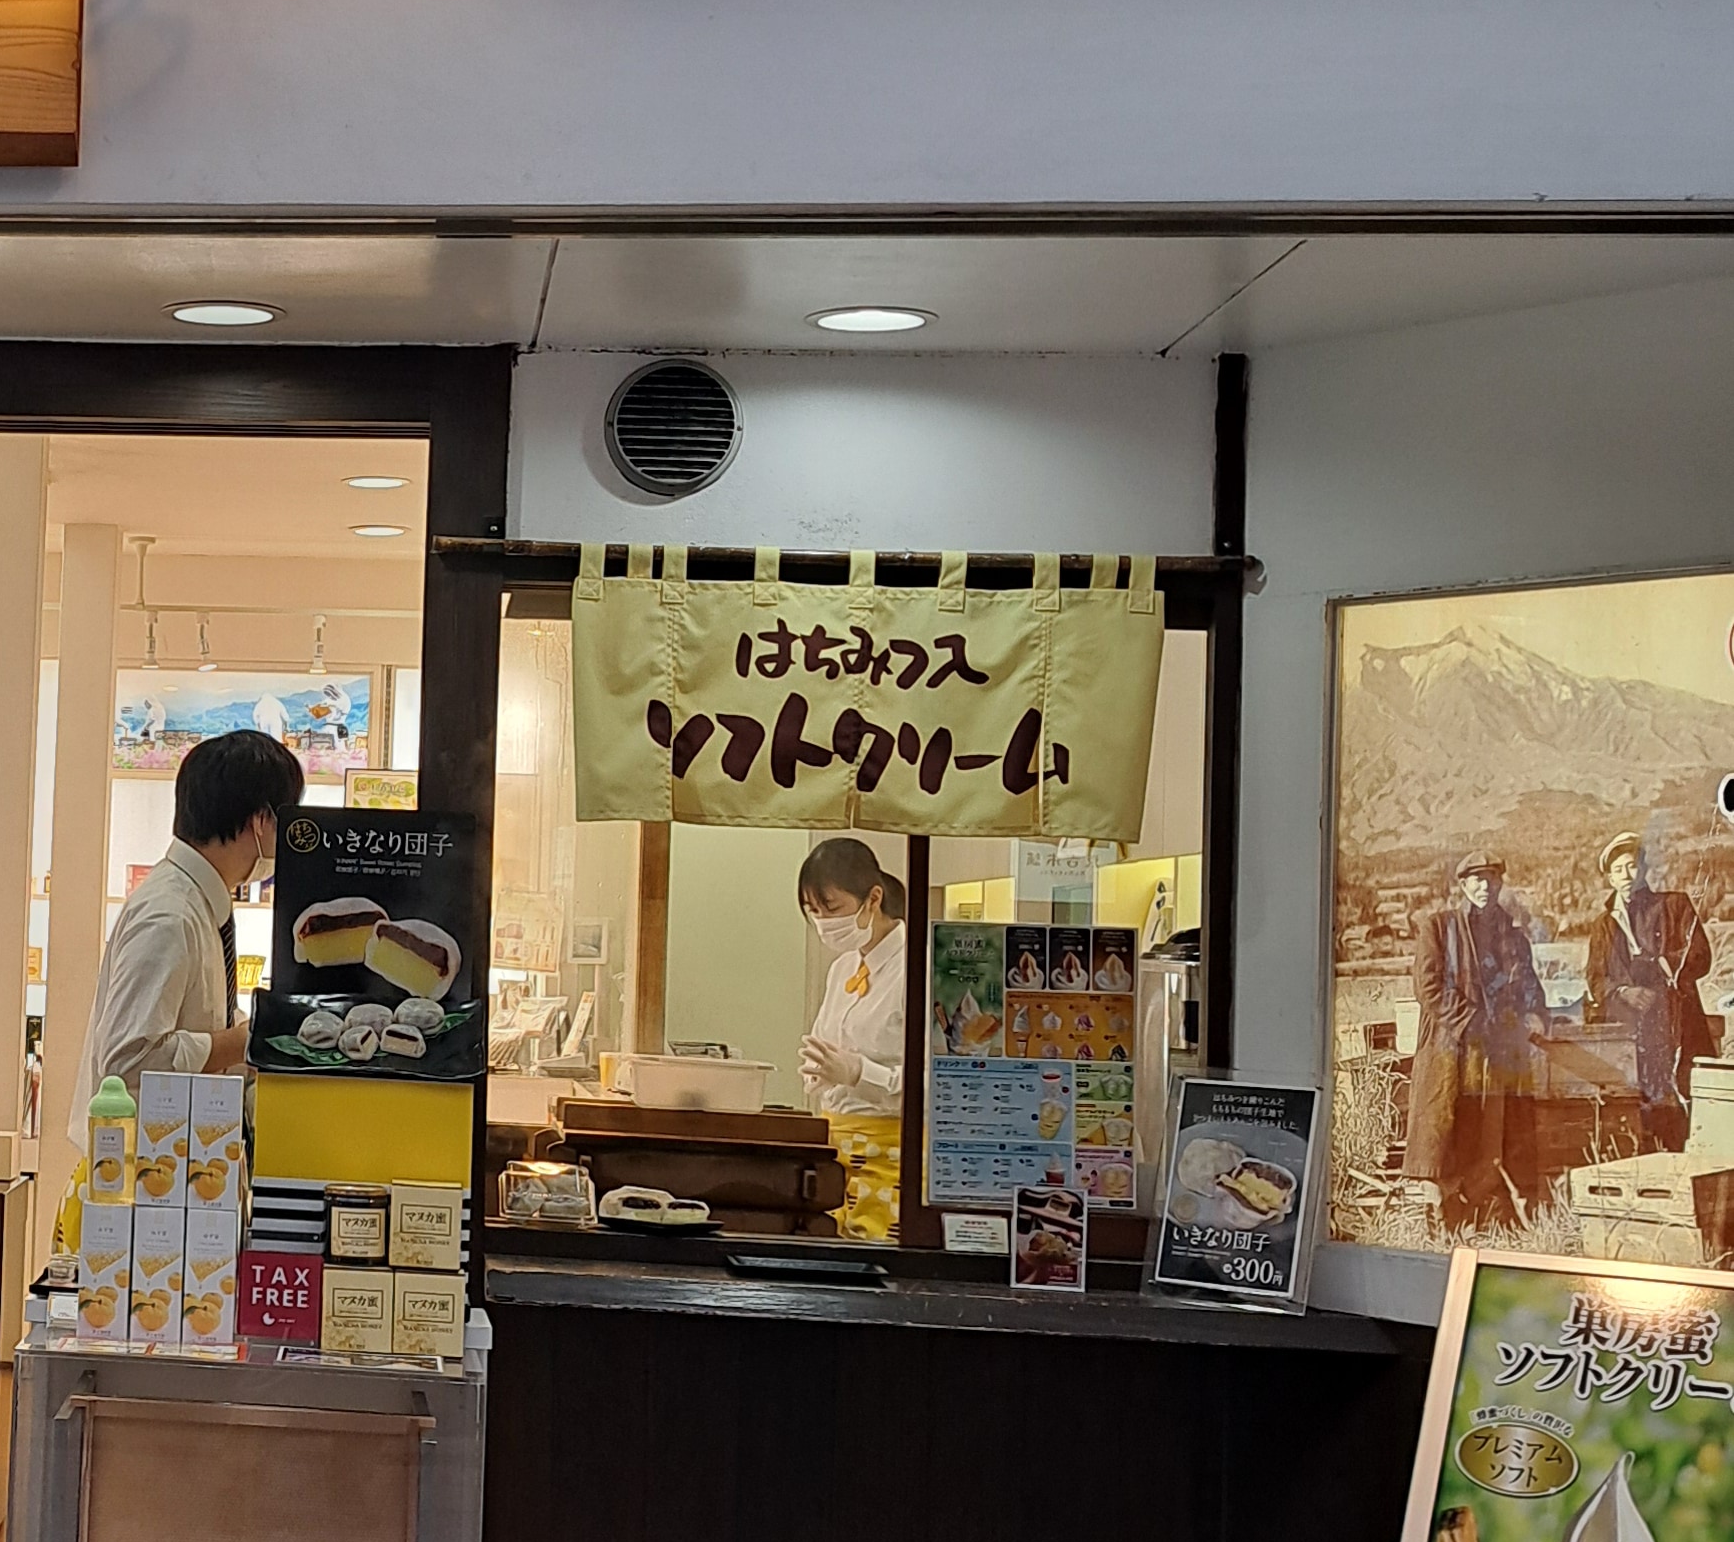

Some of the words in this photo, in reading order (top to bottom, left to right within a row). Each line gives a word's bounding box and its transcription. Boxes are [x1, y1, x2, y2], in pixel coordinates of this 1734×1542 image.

[647, 691, 1069, 796] ソフトクリーム
[323, 828, 453, 857] いきなり団子
[1172, 1225, 1271, 1253] いきなり団子
[251, 1264, 310, 1287] TAX
[251, 1287, 310, 1309] FREE
[1564, 1294, 1717, 1361] 巣房蜜
[1496, 1345, 1734, 1410] ソフトクリー
[1473, 1433, 1563, 1465] プレミアム
[1489, 1463, 1539, 1488] ソフト
